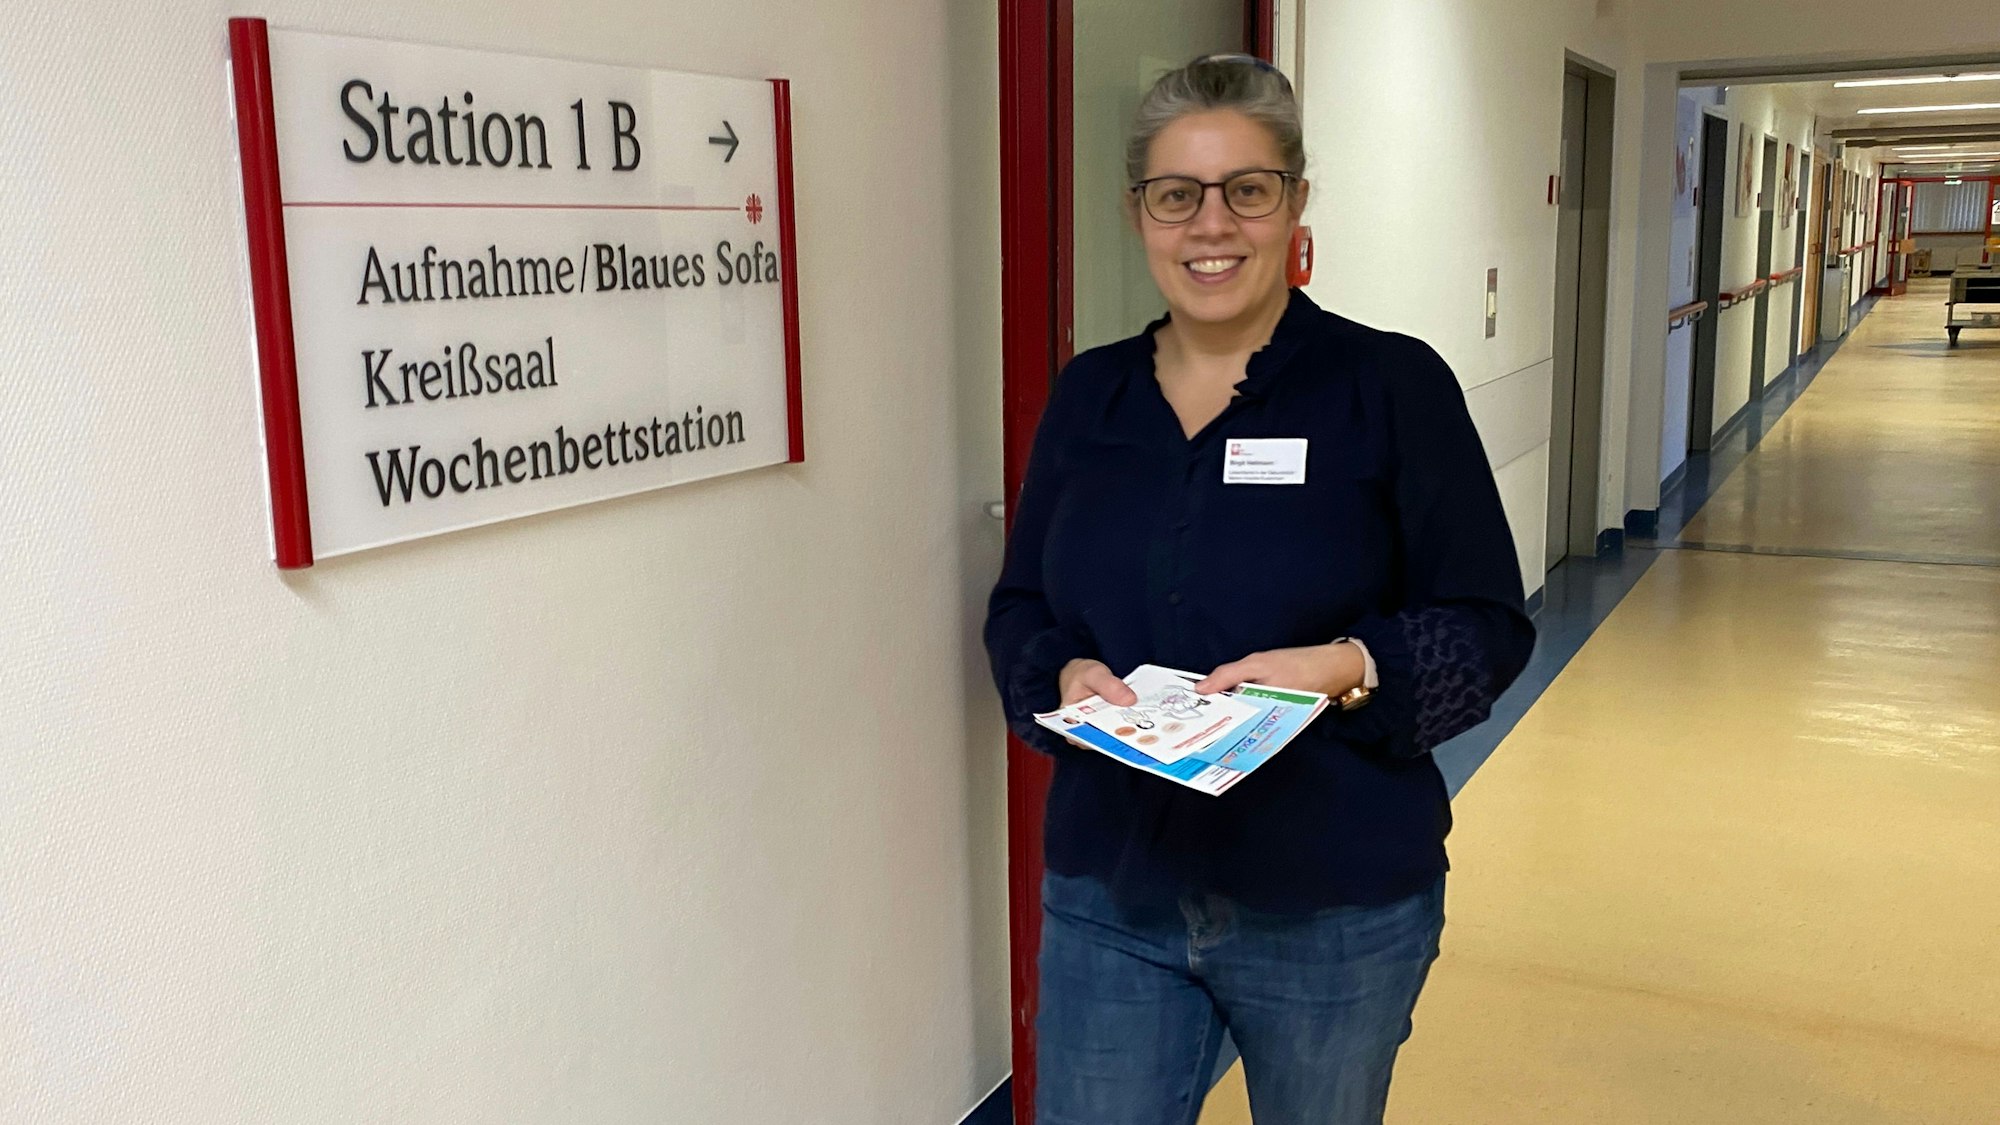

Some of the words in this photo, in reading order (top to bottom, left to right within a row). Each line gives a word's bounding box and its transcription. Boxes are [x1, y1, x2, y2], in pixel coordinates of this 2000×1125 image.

[340, 79, 553, 169] Station
[570, 98, 591, 171] 1
[607, 100, 641, 172] B
[356, 243, 706, 305] Aufnahme/Blaues
[716, 240, 779, 286] Sofa
[361, 336, 559, 409] Kreißsaal
[364, 405, 746, 507] Wochenbettstation
